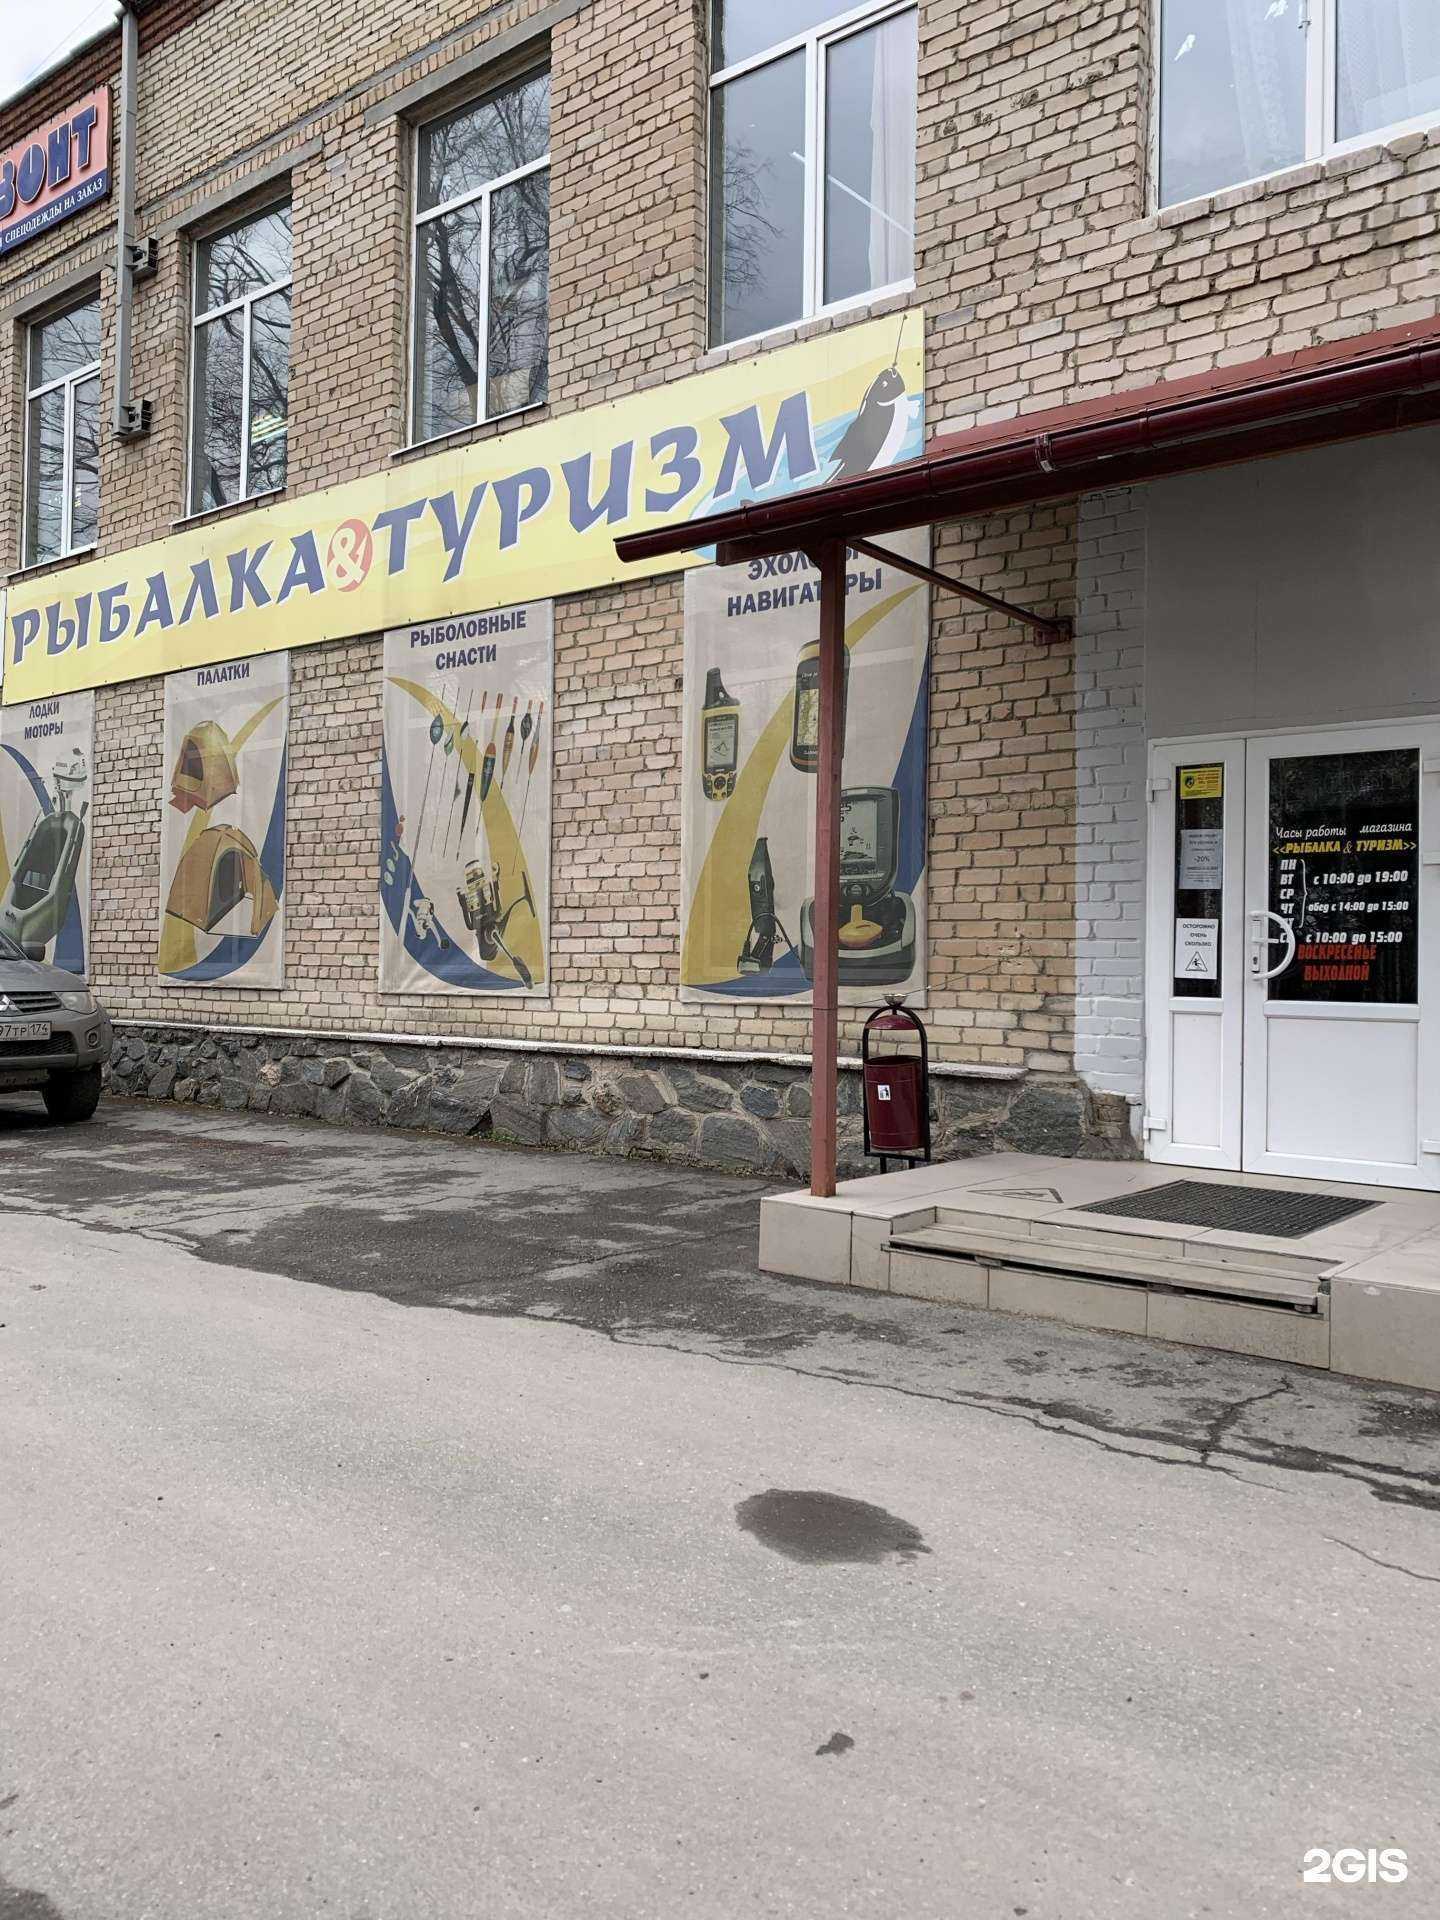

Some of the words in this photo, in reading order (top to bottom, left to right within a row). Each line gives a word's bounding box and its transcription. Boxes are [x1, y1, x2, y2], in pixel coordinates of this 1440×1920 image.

[5, 203, 62, 244] СПЕЦОДЕЖДЫ
[64, 197, 76, 212] НА
[77, 178, 103, 202] ЗАКАЗ
[11, 529, 326, 665] РЫБАЛКА
[329, 524, 371, 588] &
[372, 390, 819, 583] ТУРИЗМ
[727, 568, 882, 617] НАВИГАТРЫ
[410, 610, 526, 648] РЫБОЛОВНЫЕ
[435, 644, 497, 671] СНАСТИ
[197, 662, 250, 686] ПАЛАТКИ
[29, 701, 60, 719] ЛОДКИ
[24, 721, 64, 740] МОТОРЫ
[1276, 827, 1302, 838] Часы
[1306, 825, 1347, 840] работы
[1360, 823, 1412, 833] магазина
[1343, 841, 1352, 854] &
[1280, 859, 1297, 870] ПН
[1280, 874, 1294, 885] ВТ
[1313, 876, 1319, 884] с
[1323, 873, 1355, 884] 10:00
[1357, 874, 1371, 885] до
[1375, 871, 1408, 882] 19:00
[1280, 889, 1294, 899] СР
[1280, 903, 1294, 914] ЧТ
[1308, 902, 1329, 913] обед
[1331, 903, 1337, 911] с
[1339, 902, 1365, 911] 14:00
[1367, 903, 1379, 913] до
[1382, 901, 1409, 911] 15:00
[1306, 934, 1312, 943] с
[1315, 932, 1347, 943] 10:00
[1351, 933, 1366, 945] до
[1370, 931, 1403, 943] 15:00
[1298, 944, 1377, 960] ВОСКРЕСЕНЬЕ
[30, 1023, 48, 1033] 174
